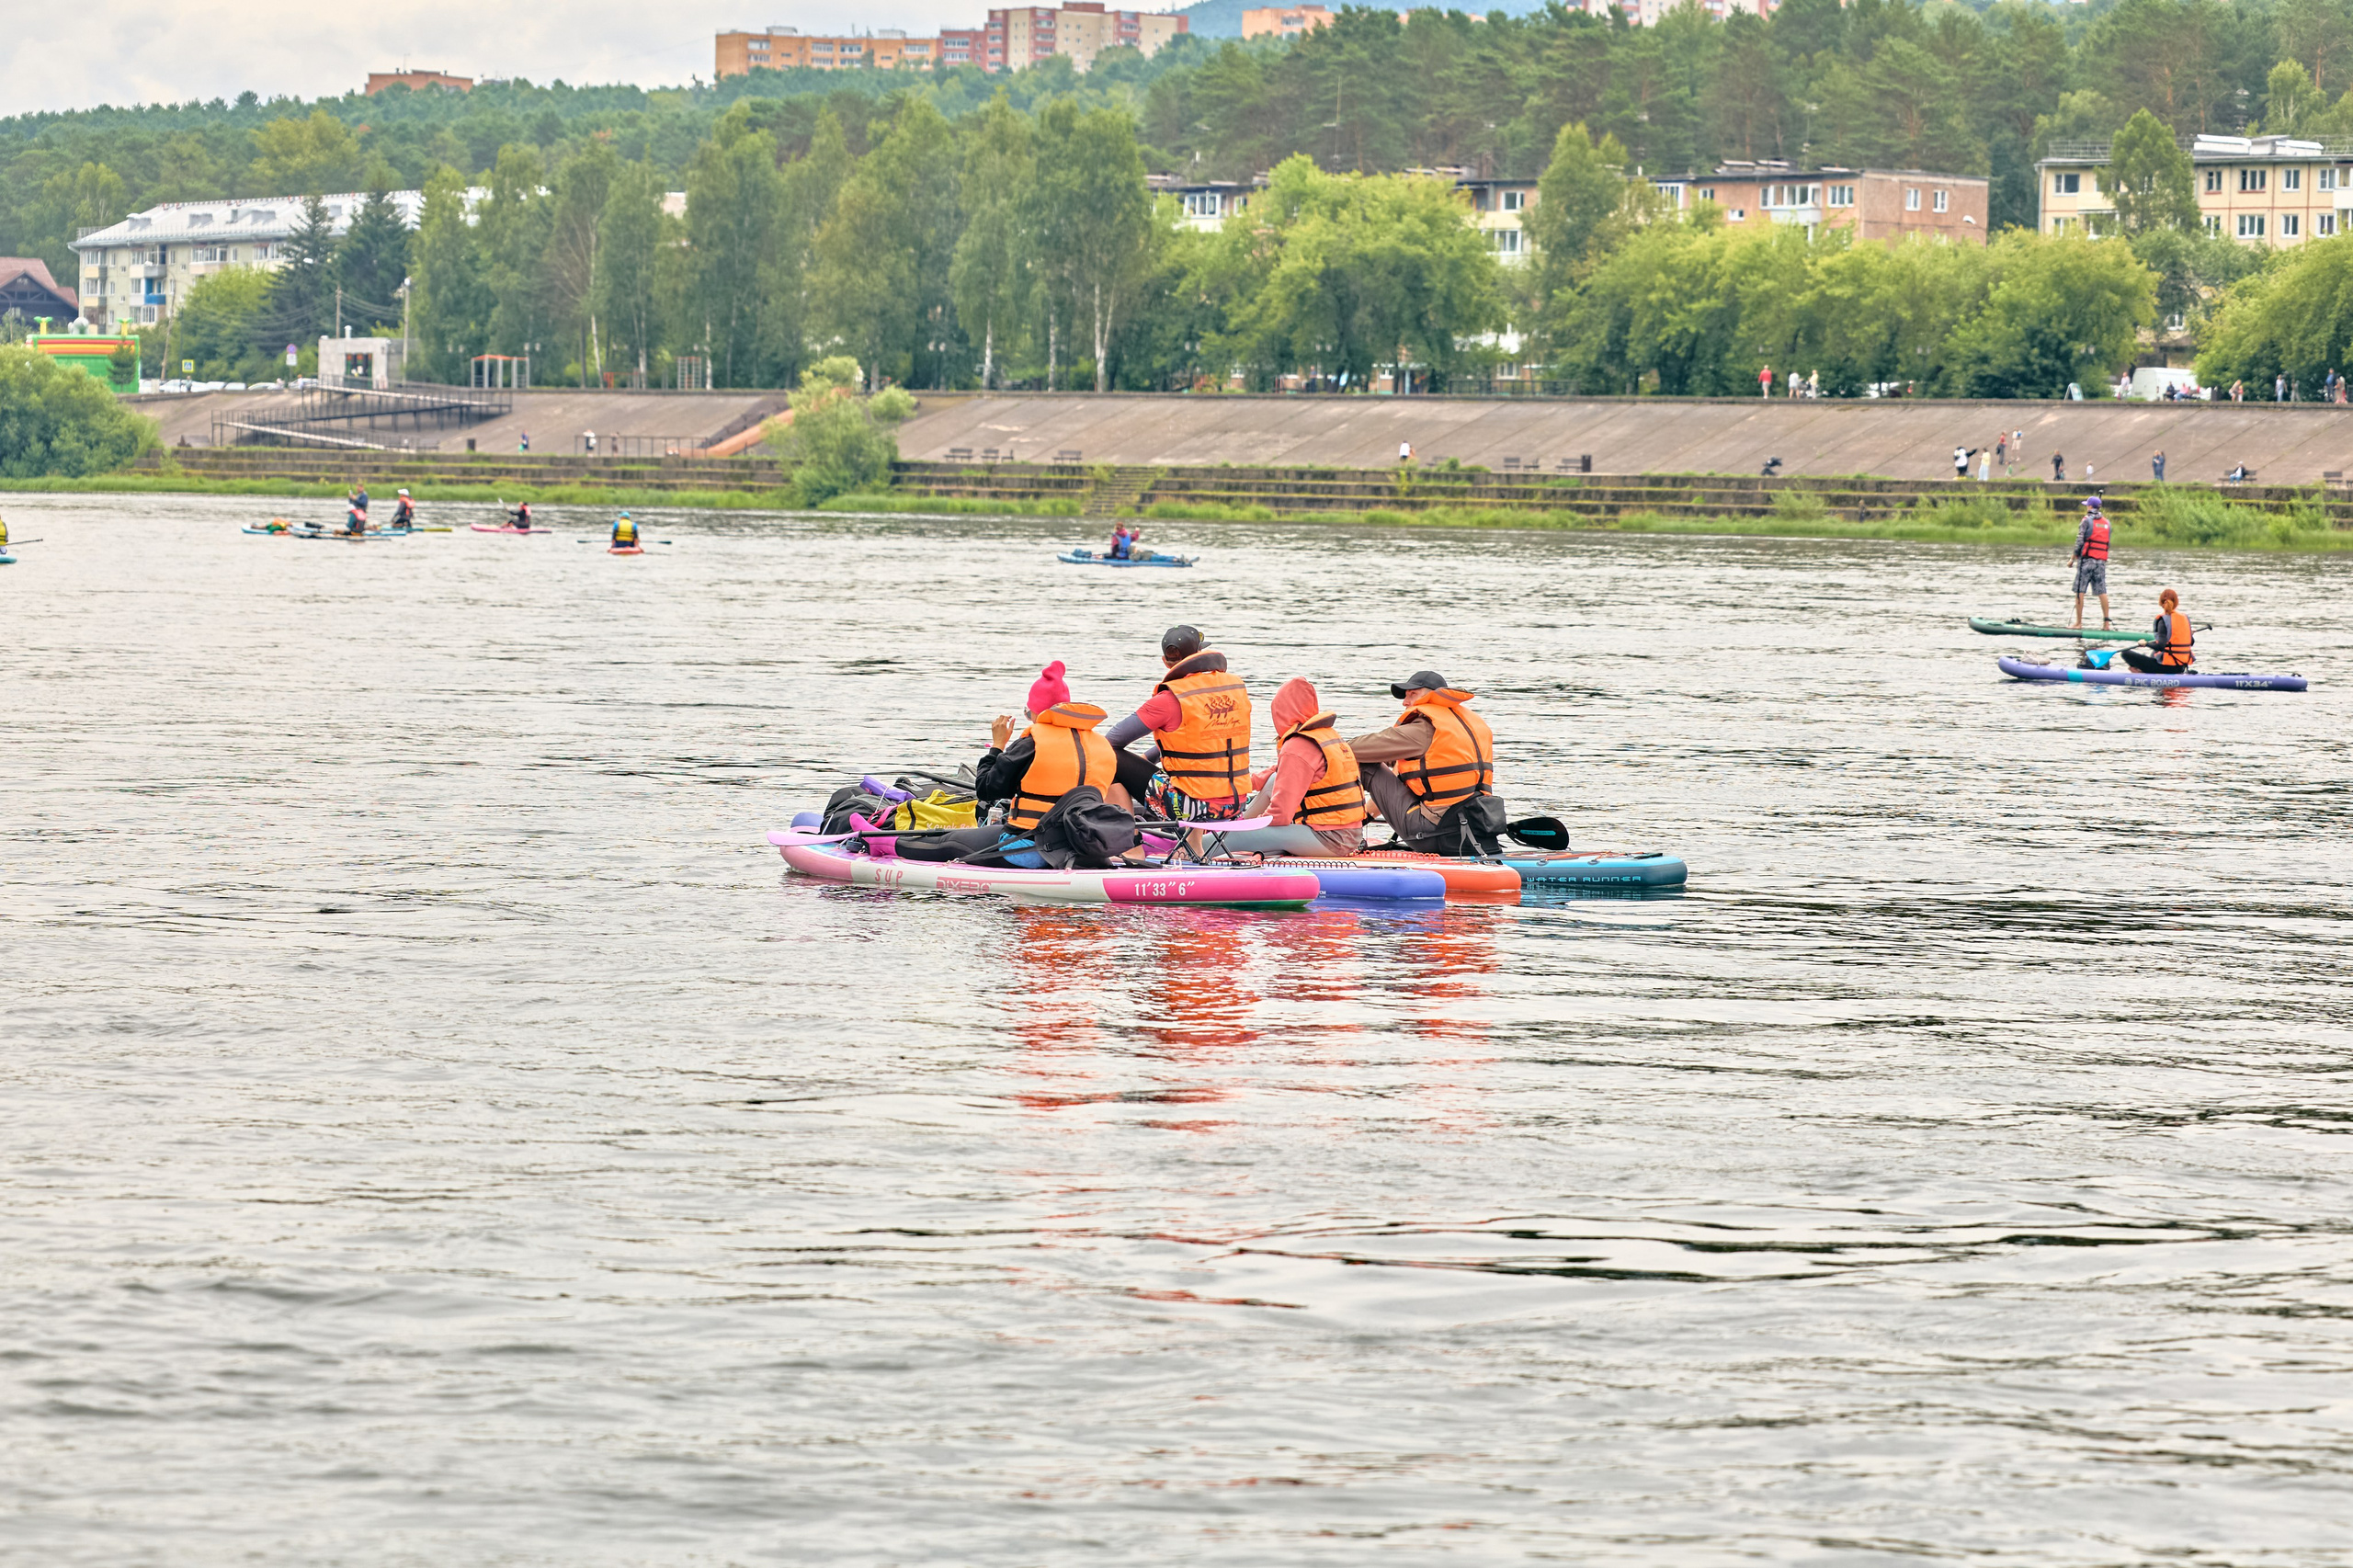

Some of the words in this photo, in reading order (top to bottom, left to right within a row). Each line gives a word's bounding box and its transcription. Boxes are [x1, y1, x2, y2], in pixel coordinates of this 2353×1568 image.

[2134, 678, 2148, 687] PIC
[2150, 678, 2180, 687] BOARD
[874, 868, 904, 883] SUP
